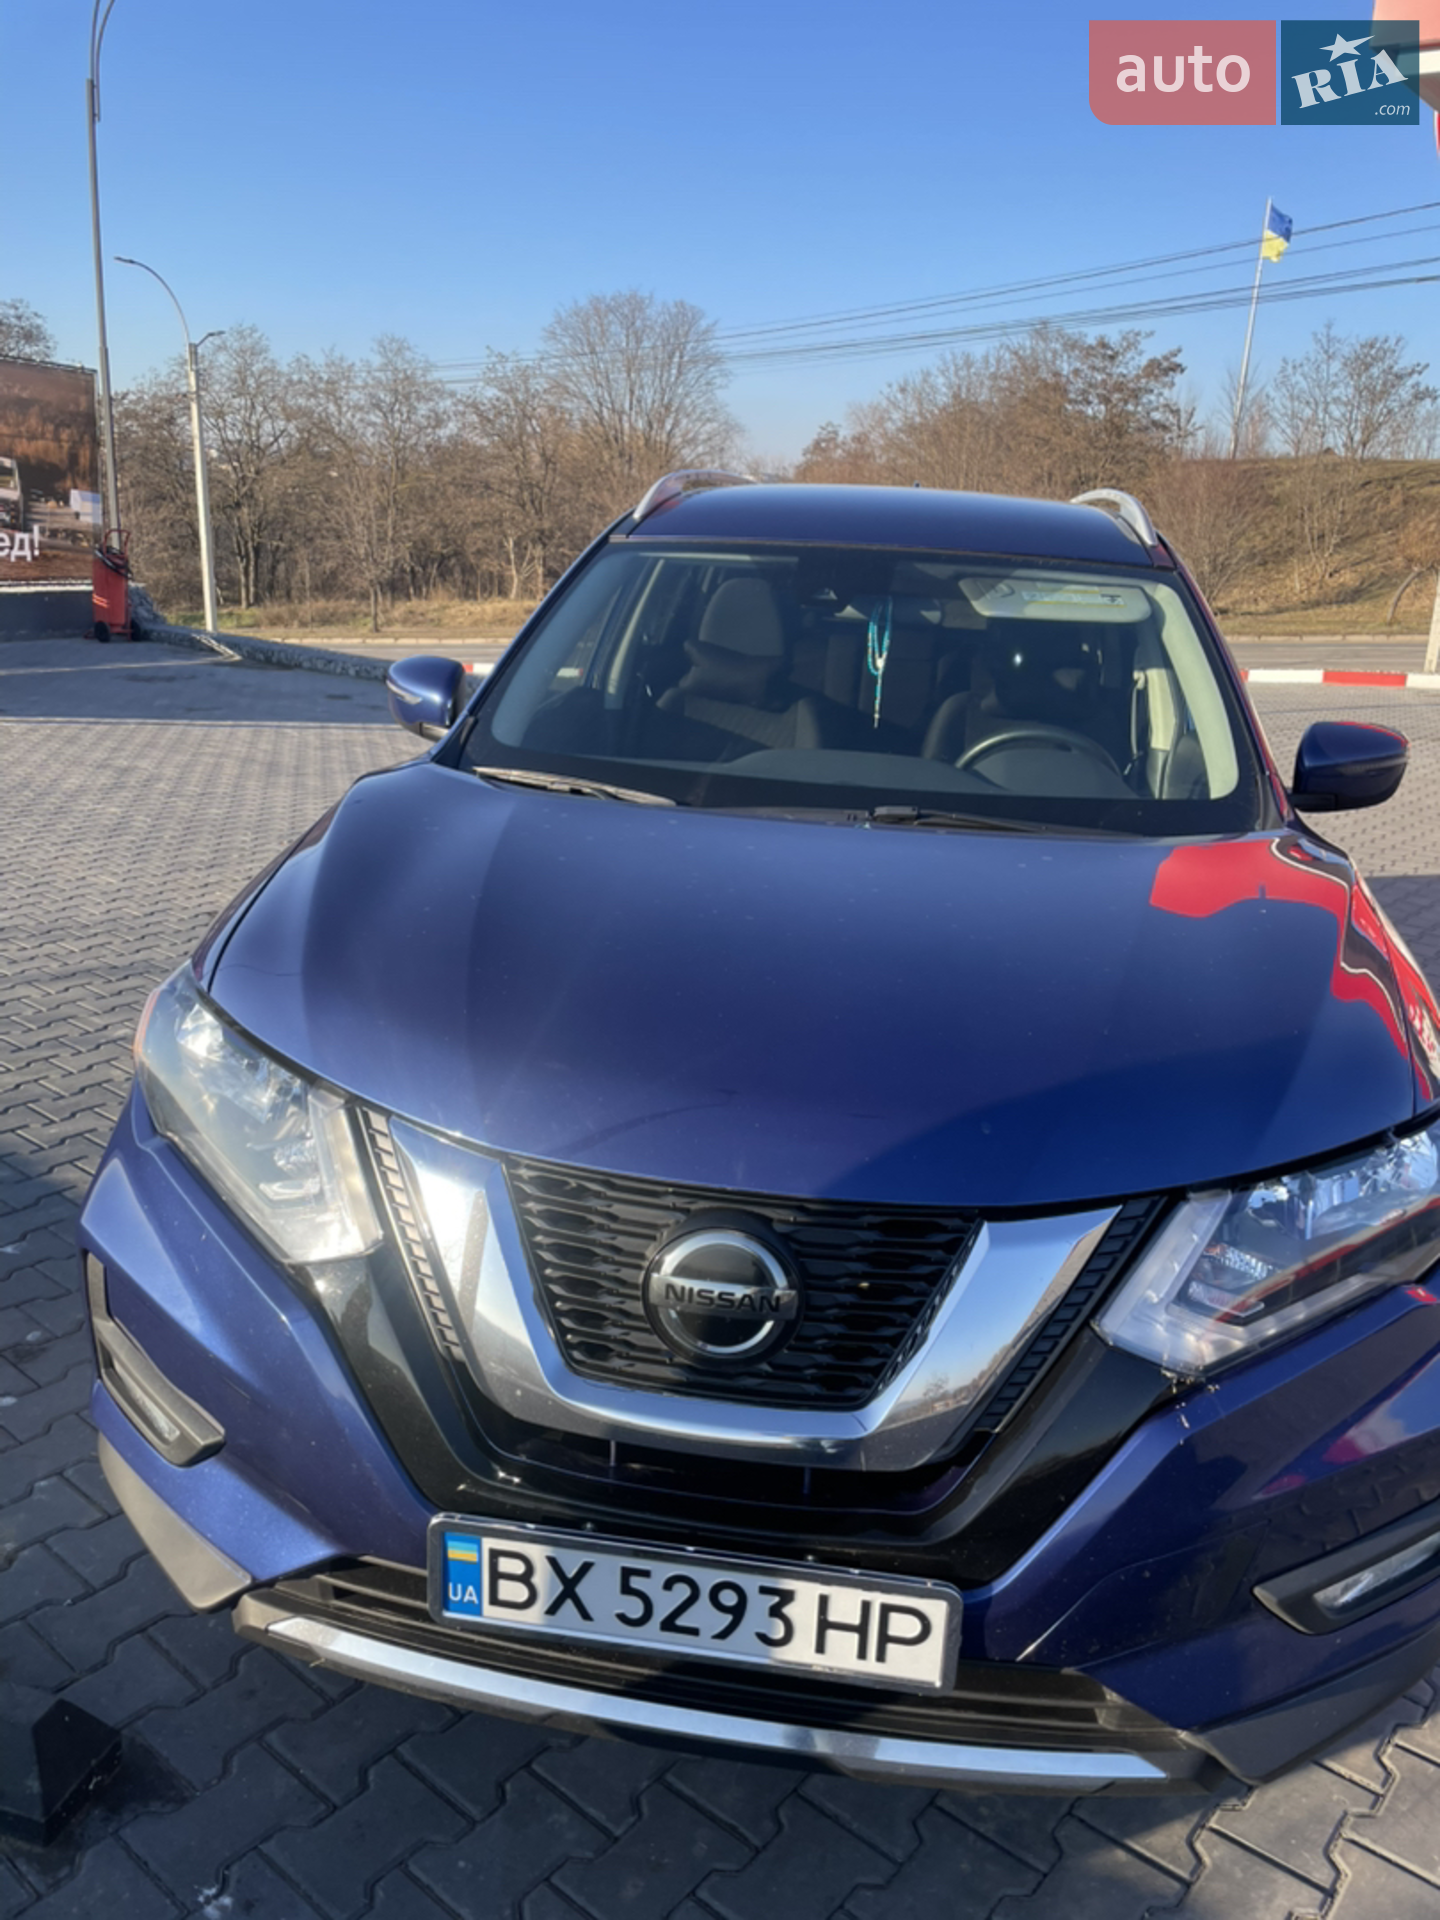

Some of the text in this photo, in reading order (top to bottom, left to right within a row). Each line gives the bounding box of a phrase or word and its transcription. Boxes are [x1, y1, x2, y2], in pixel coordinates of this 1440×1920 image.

[665, 1284, 780, 1313] NISSAN
[448, 1582, 480, 1607] UA
[488, 1547, 932, 1663] BX 5293 HP
